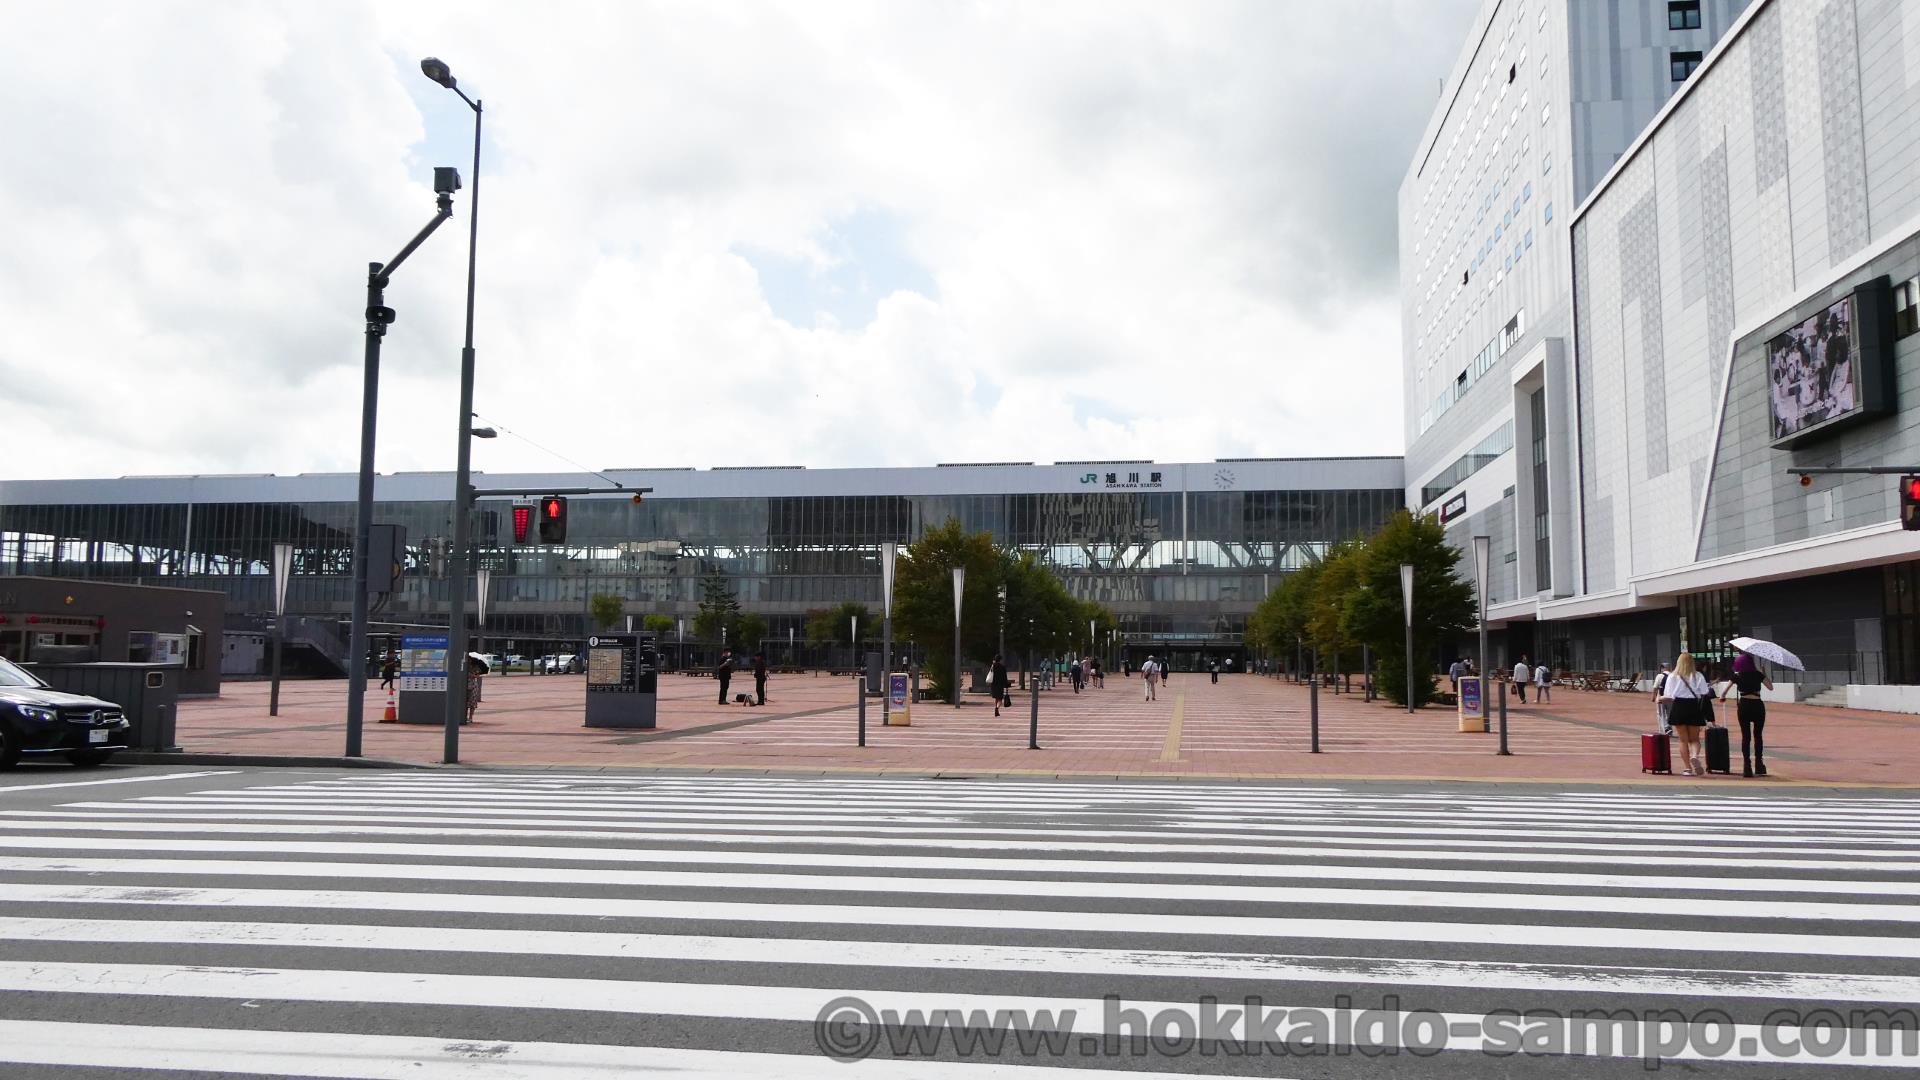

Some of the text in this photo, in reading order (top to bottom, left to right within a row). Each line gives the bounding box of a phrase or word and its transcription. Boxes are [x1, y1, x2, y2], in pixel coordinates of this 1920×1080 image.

[1080, 473, 1098, 484] JR
[1105, 472, 1162, 483] 旭川駅
